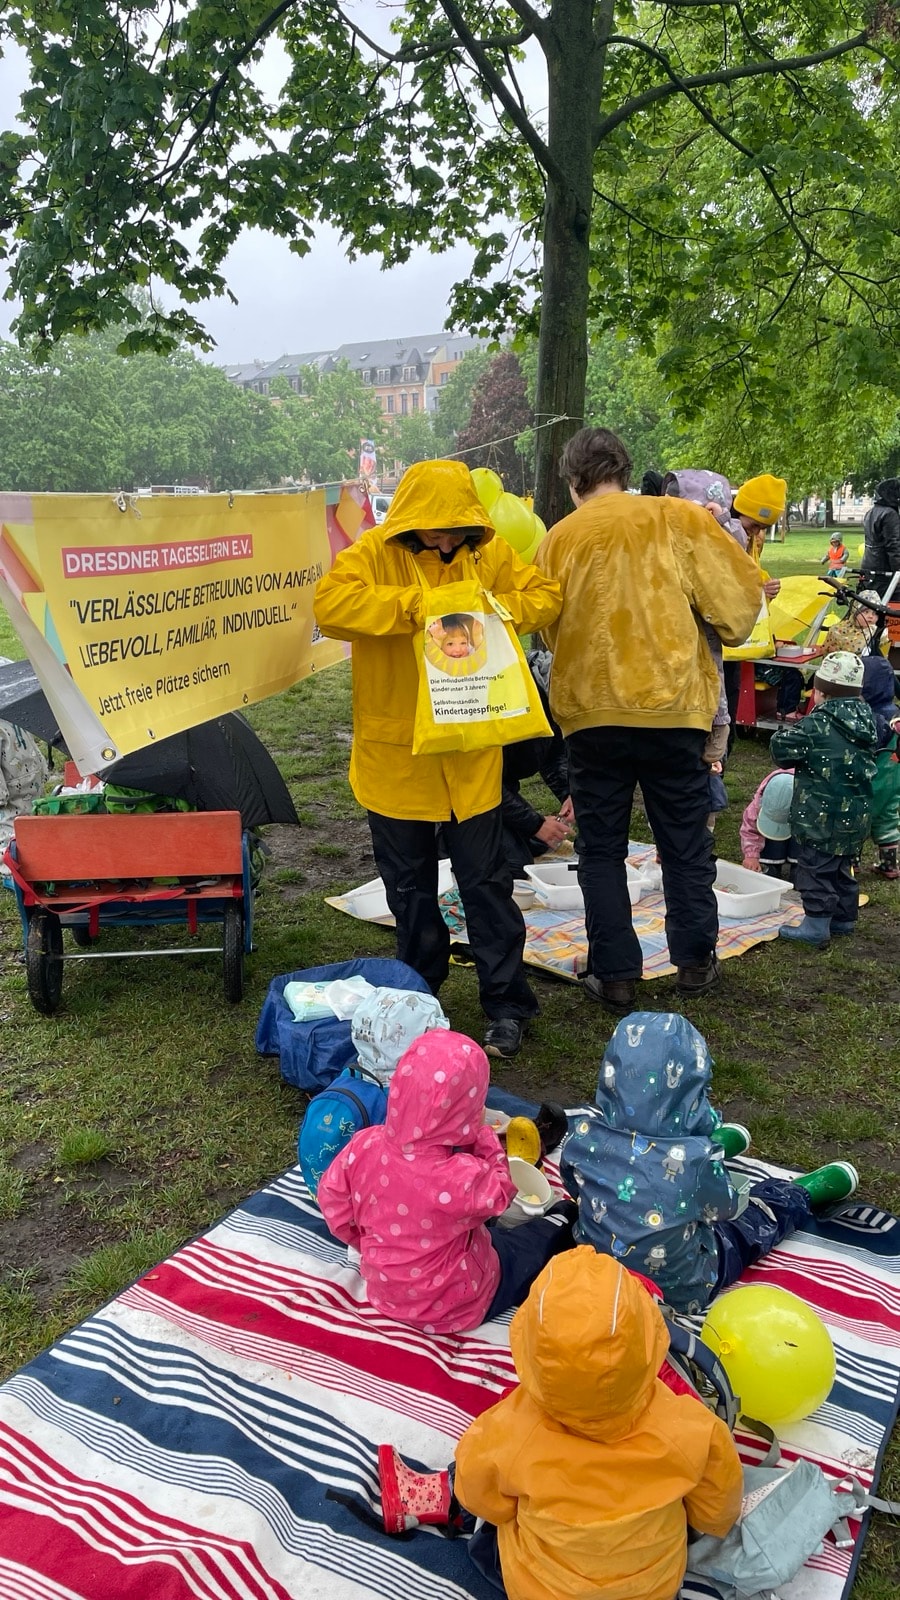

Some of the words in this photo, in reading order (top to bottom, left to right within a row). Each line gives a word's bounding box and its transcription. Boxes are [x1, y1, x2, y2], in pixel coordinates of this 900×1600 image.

[65, 547, 159, 574] DRESDNER
[161, 540, 229, 568] TAGESELTERN
[232, 538, 252, 557] E.V.
[70, 589, 192, 624] "VERLÄSSLICHE
[193, 577, 253, 607] BETREUUNG
[256, 571, 282, 593] VON
[79, 632, 164, 669] LIEBEVOLL,
[166, 615, 218, 650] FAMILIÄR,
[98, 692, 124, 717] Jetzt
[125, 682, 153, 706] freie
[156, 673, 190, 698] Plätze
[192, 660, 231, 687] sichern
[434, 703, 507, 716] Kindertagespflege!
